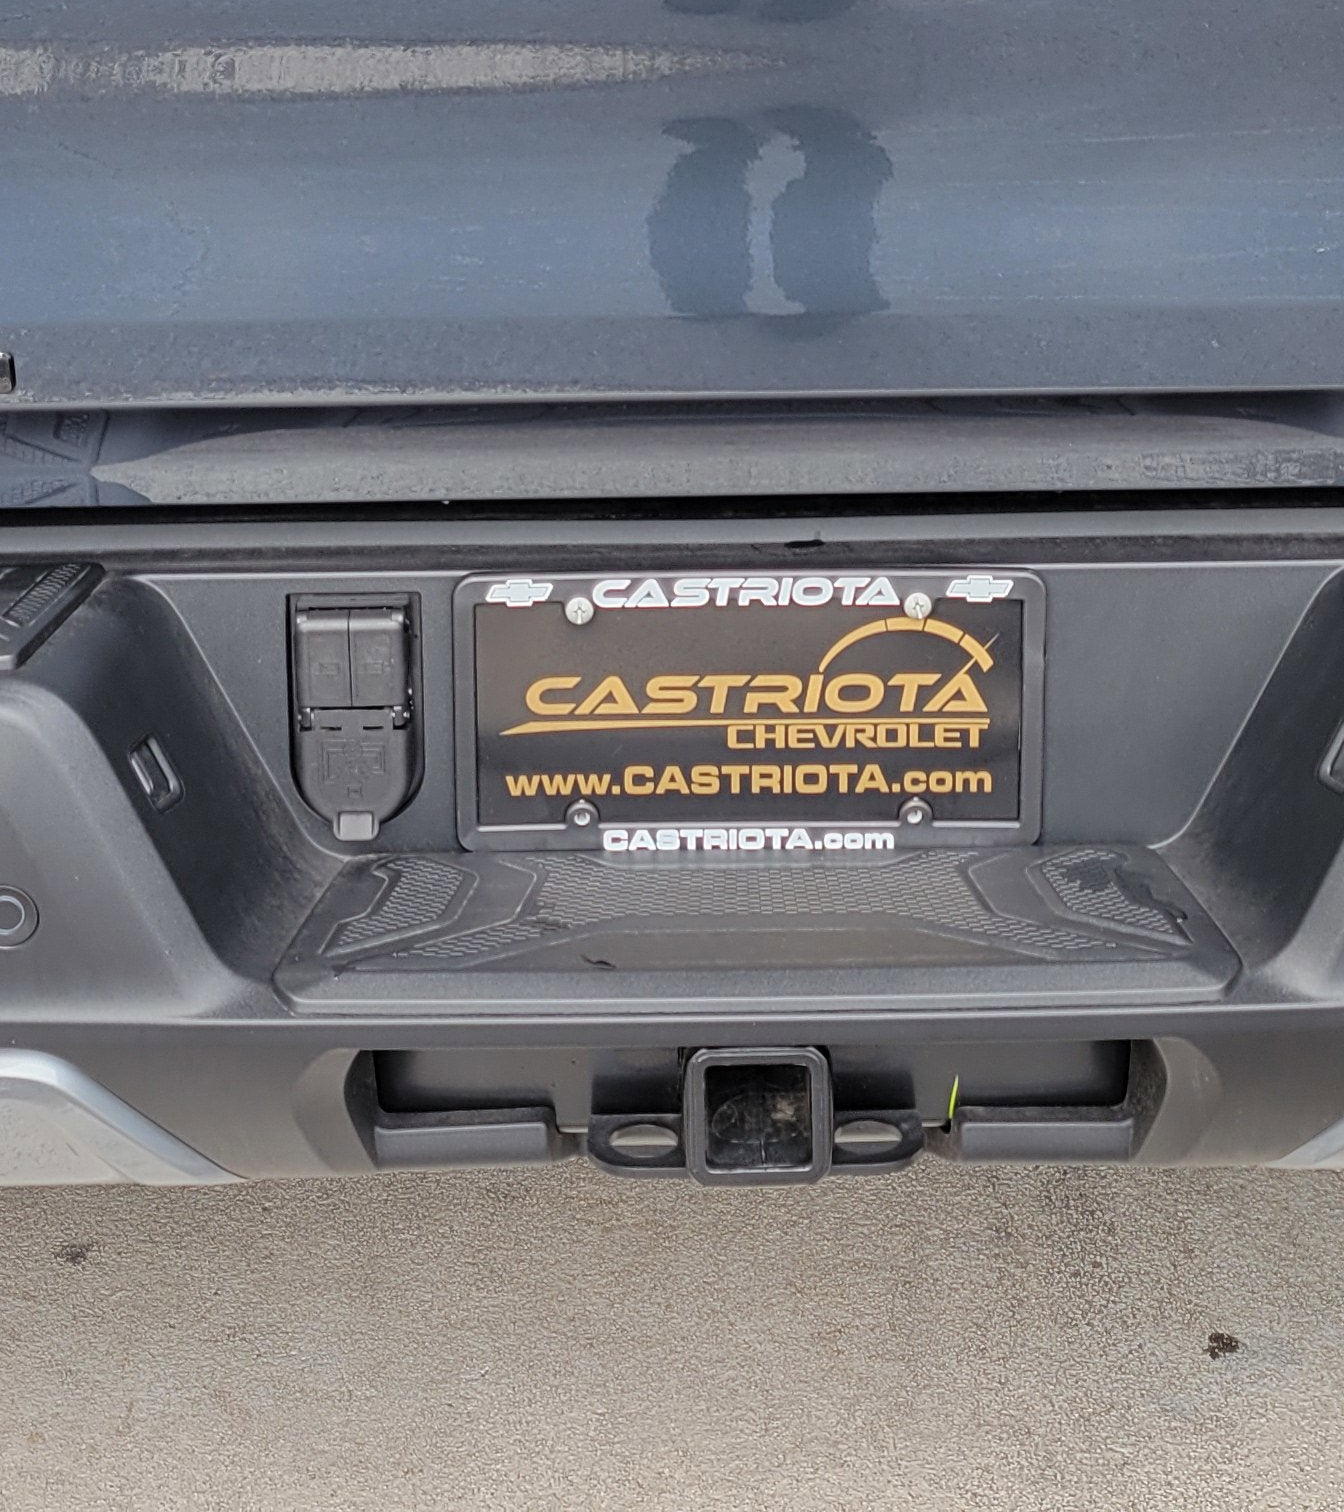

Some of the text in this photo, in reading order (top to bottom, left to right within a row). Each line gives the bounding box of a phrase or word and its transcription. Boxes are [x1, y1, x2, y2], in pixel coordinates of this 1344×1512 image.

[592, 577, 901, 608] CASTRIOTA
[525, 673, 988, 715] CASTRIOTA
[727, 724, 988, 749] CHEVROLET
[505, 764, 993, 797] www.CASTRIOTA.com
[602, 828, 895, 851] CASTRIOTA.com
